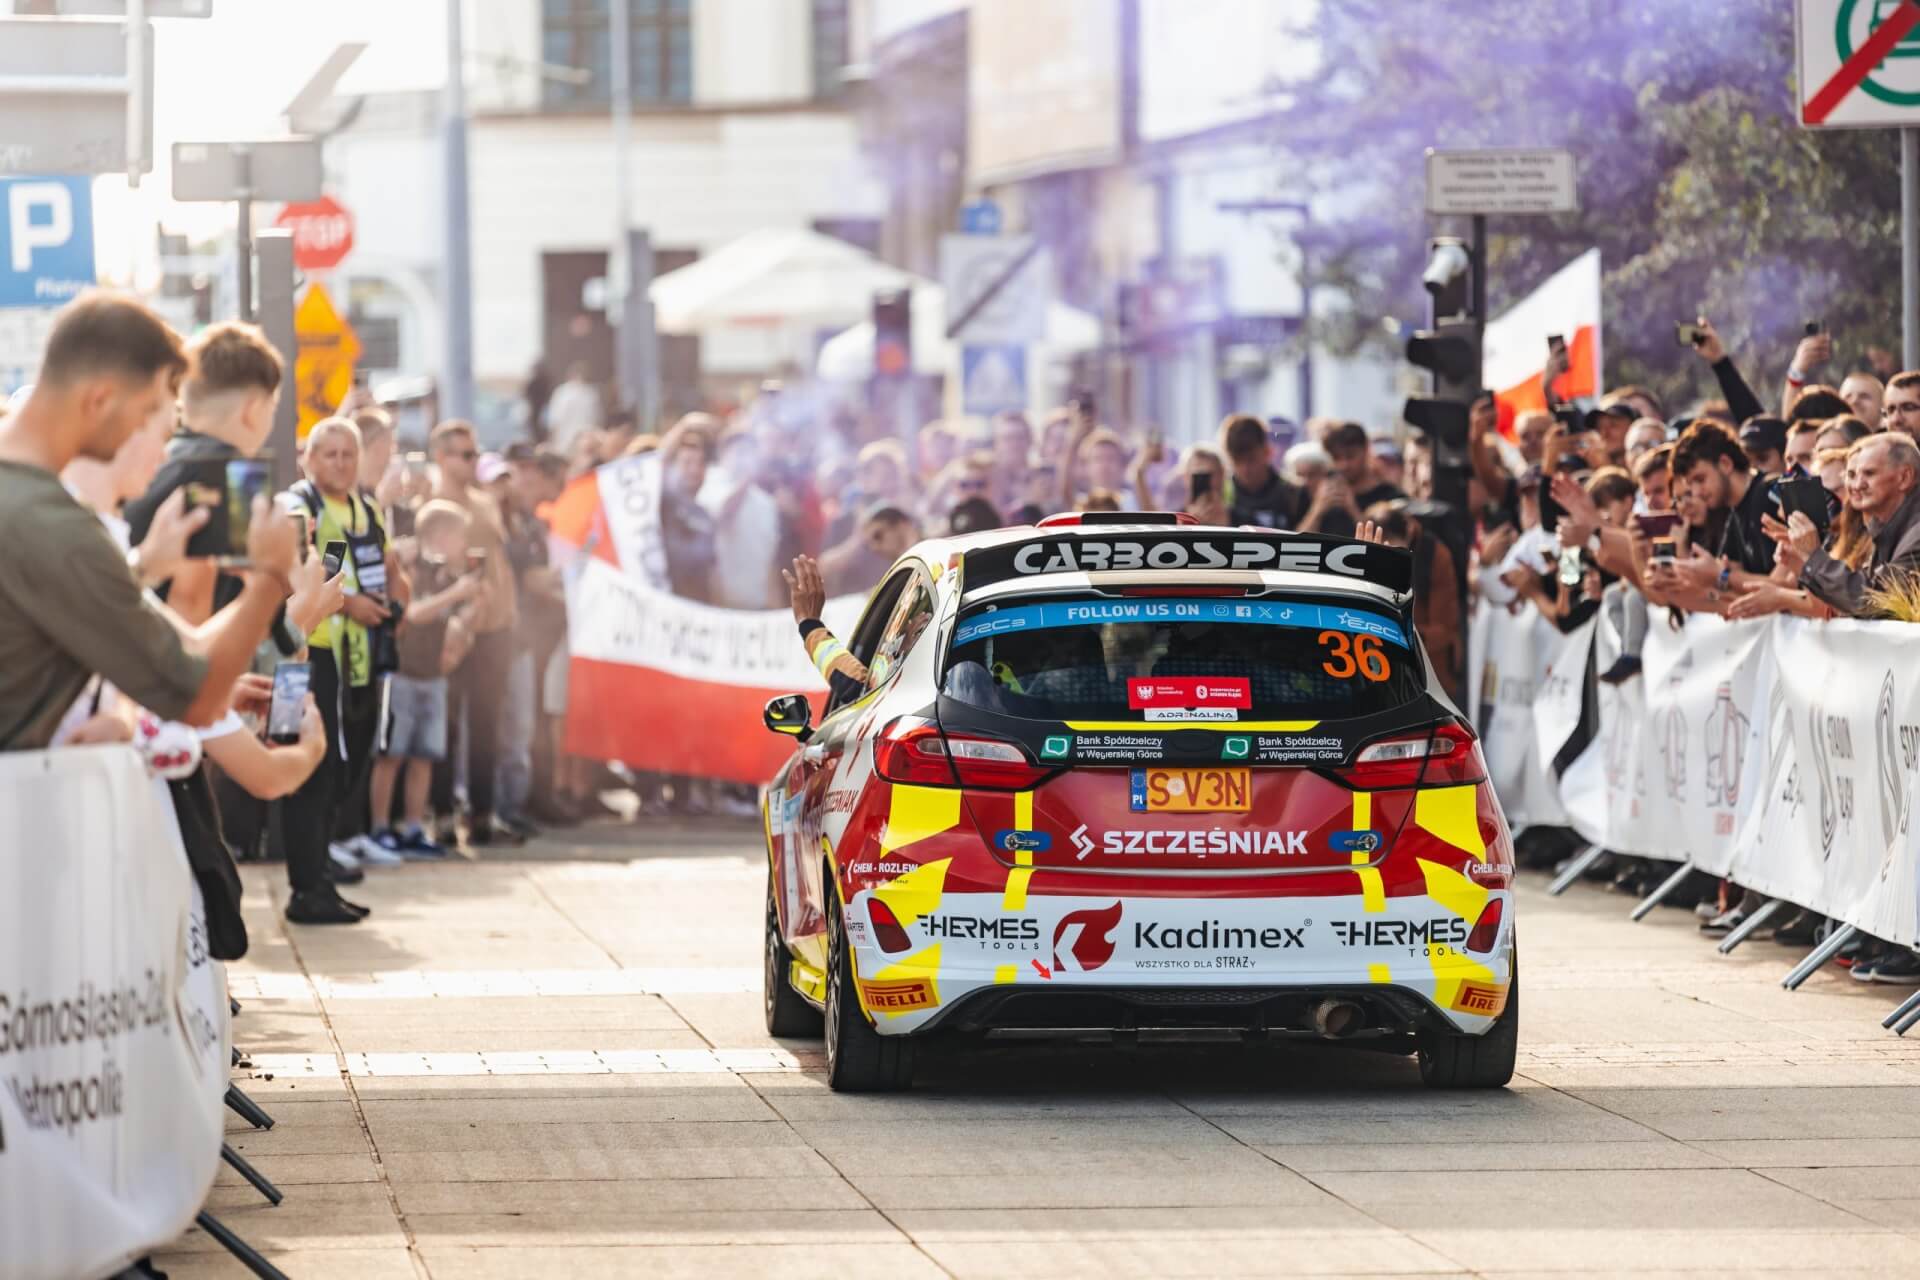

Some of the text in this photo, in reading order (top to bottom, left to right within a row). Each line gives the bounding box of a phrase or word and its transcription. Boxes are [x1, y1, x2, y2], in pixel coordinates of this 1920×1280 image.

[8, 182, 72, 272] P
[1014, 542, 1367, 576] CARBOSPEC
[1067, 604, 1200, 620] FOLLOW US ON
[1318, 630, 1391, 682] 36
[1157, 711, 1234, 719] ADRENALINA
[1076, 736, 1163, 747] Bank Spółdzielczy
[1258, 737, 1342, 748] Bank Spółdzielczy
[1137, 750, 1163, 759] Górce
[1268, 750, 1317, 761] Węgierskiej
[1318, 750, 1343, 760] Górce
[1103, 827, 1309, 859] SZCZĘŚNIAK
[929, 915, 1040, 940] HERMES
[1348, 917, 1467, 946] HERMES
[980, 941, 1040, 950] TOOLS
[1409, 947, 1468, 957] TOOLS
[1135, 960, 1190, 969] WSZYSTKO
[1193, 960, 1213, 968] DLA
[862, 983, 928, 1007] PIRELLI
